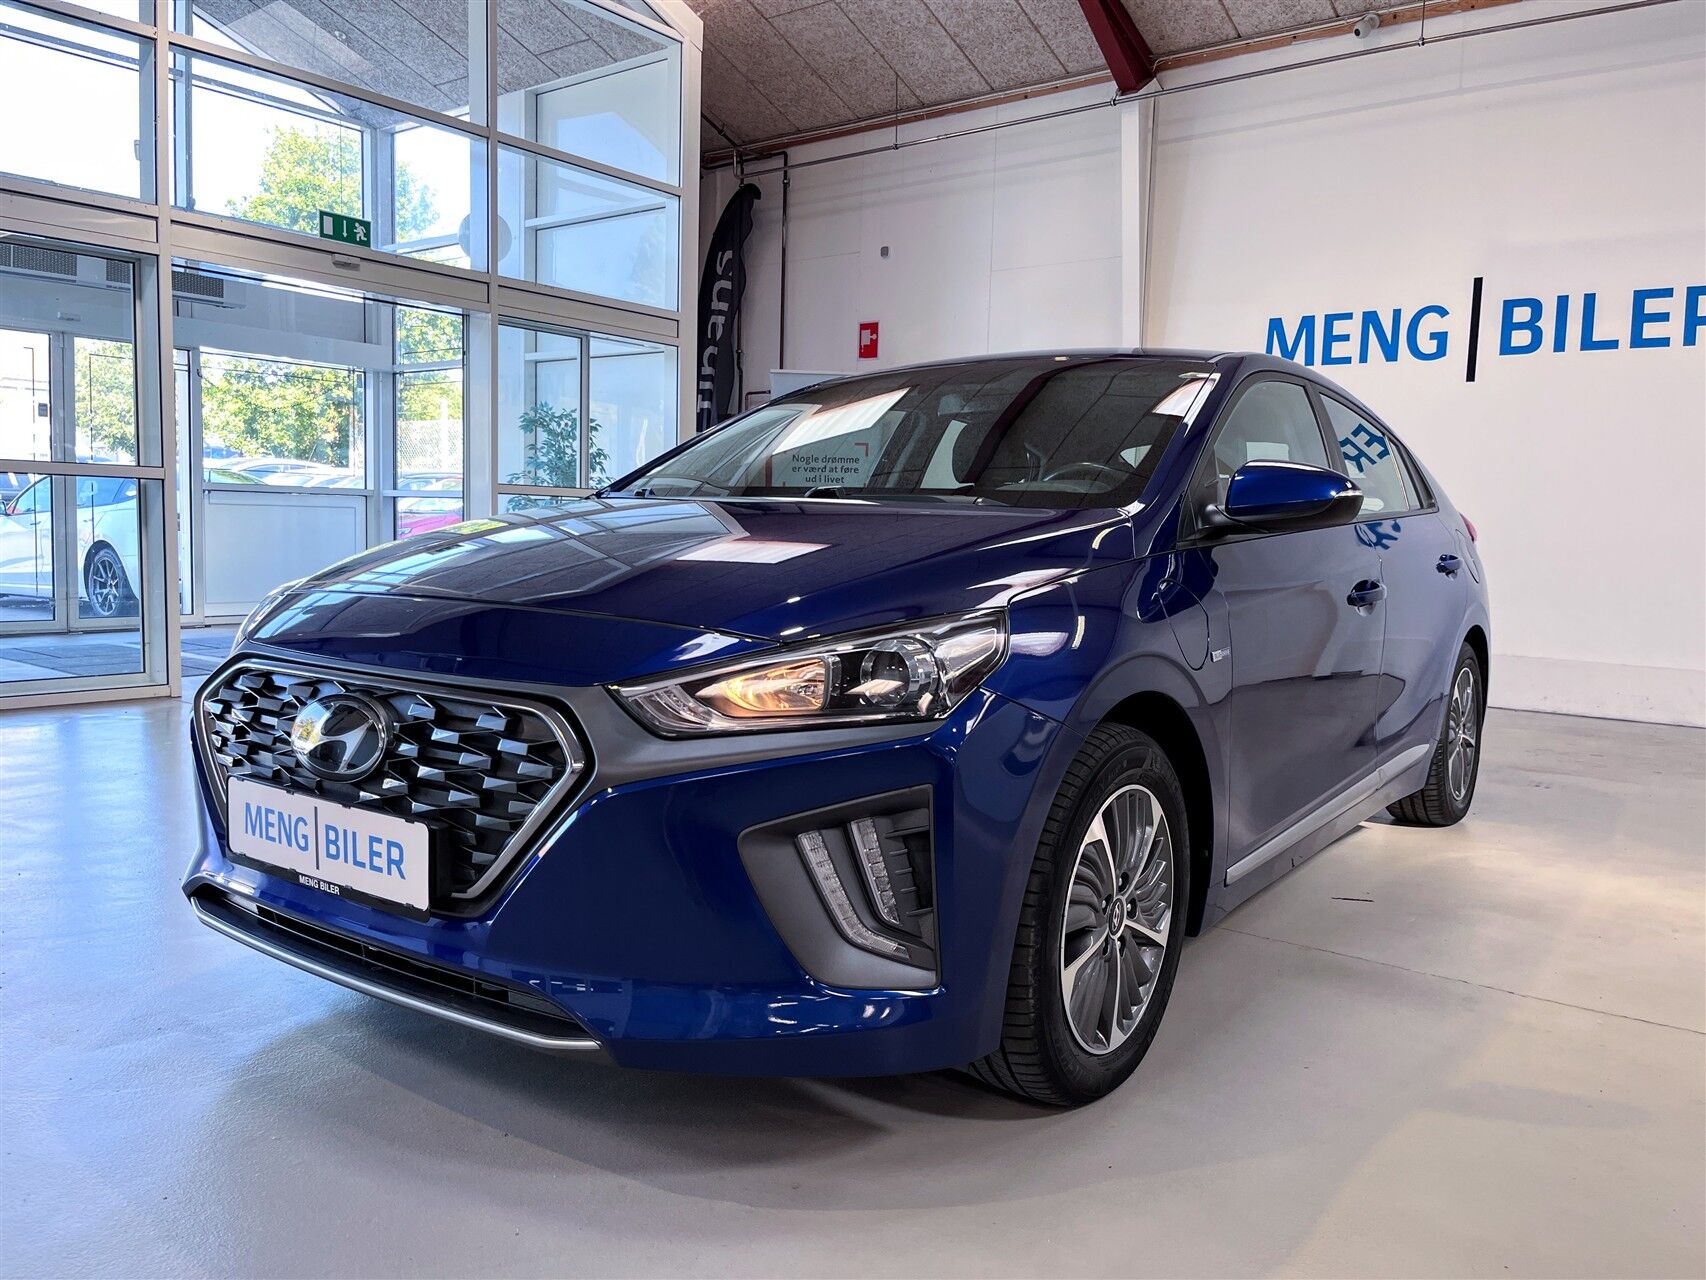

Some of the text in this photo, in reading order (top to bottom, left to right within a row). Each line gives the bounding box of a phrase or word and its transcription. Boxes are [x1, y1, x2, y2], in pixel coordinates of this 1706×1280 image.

[1265, 305, 1450, 366] MENG
[792, 454, 860, 465] Nogle drømme
[804, 465, 827, 473] værd
[840, 465, 859, 473] føre
[805, 475, 817, 483] ud
[824, 475, 845, 484] livet
[245, 802, 406, 880] MENG BILER
[299, 874, 340, 895] MENG BILER
